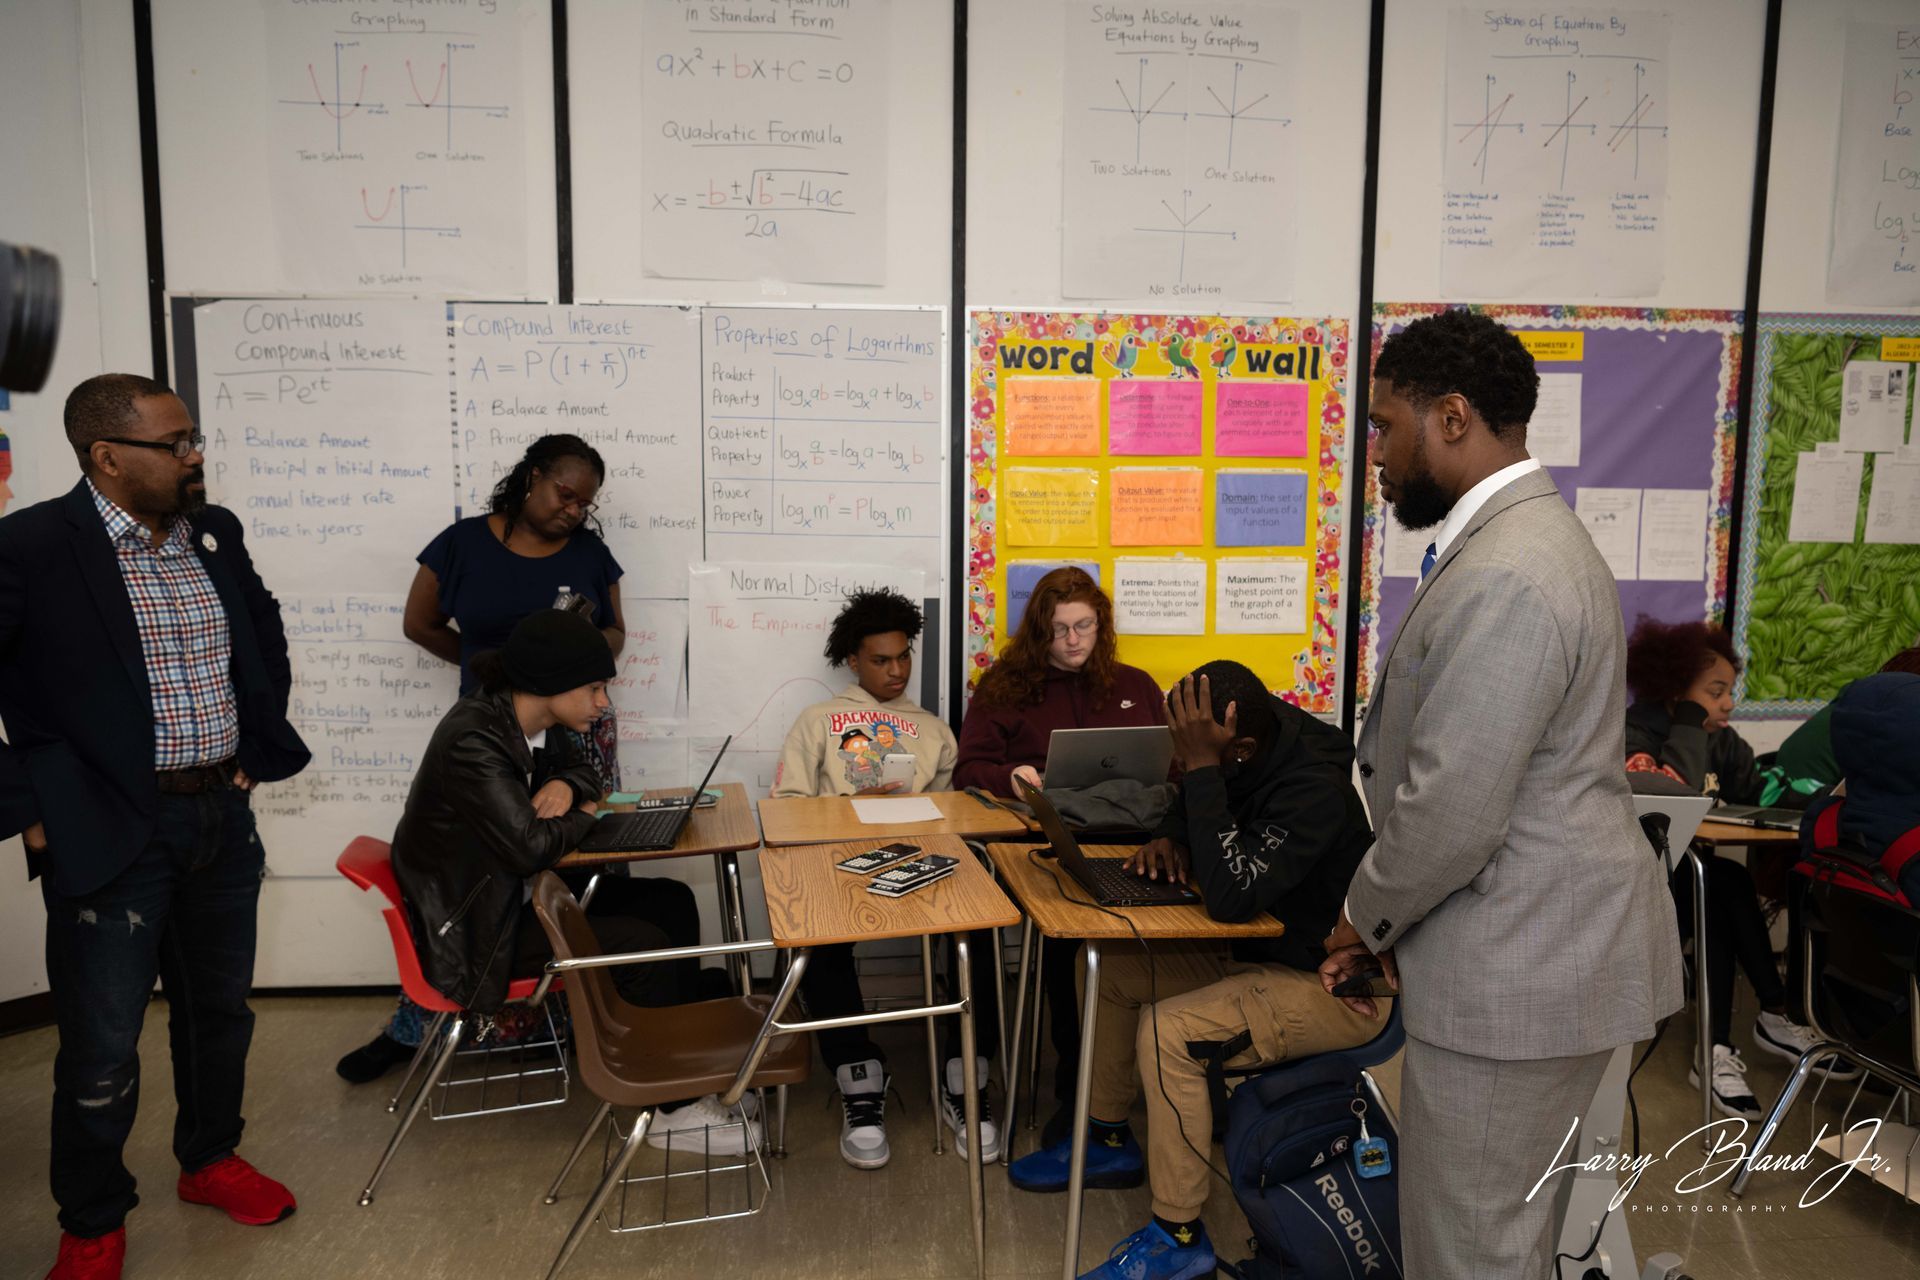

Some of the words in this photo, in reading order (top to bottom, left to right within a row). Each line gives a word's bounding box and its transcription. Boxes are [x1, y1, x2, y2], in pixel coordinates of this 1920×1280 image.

[351, 12, 426, 32] Graphing
[710, 6, 776, 24] Standard
[790, 9, 834, 30] Form
[1090, 5, 1135, 27] Solving
[1210, 15, 1243, 28] Value
[1609, 16, 1626, 36] By
[1105, 27, 1175, 46] Equations
[1181, 31, 1198, 50] by
[1204, 31, 1259, 53] Graphing
[1524, 33, 1579, 54] Graphing
[662, 120, 756, 142] Quadratic
[768, 120, 842, 145] Formula
[1884, 123, 1912, 137] Base
[244, 303, 364, 334] Continuous
[462, 314, 554, 341] Compound
[568, 311, 634, 336] Interest
[715, 316, 799, 353] Properties
[810, 325, 839, 352] of
[848, 327, 935, 357] Logarithms
[235, 341, 331, 367] Compound
[339, 340, 407, 361] Interest
[1000, 342, 1094, 375] word
[1246, 345, 1321, 380] wall
[712, 362, 756, 382] Product
[491, 397, 548, 417] Balance
[557, 401, 610, 417] Amount
[712, 388, 760, 407] Property
[245, 426, 309, 449] Balance
[319, 432, 371, 449] Amount
[625, 429, 679, 445] Amount
[708, 426, 768, 440] Quotient
[711, 447, 762, 465] Property
[250, 458, 307, 482] Principal
[336, 456, 373, 476] Initial
[380, 461, 432, 479] Amount
[609, 462, 646, 479] rate
[363, 491, 396, 505] rate
[712, 482, 751, 499] Power
[1261, 493, 1275, 502] the
[1278, 494, 1291, 502] set
[713, 506, 763, 527] Property
[1226, 506, 1249, 516] input
[1251, 506, 1279, 515] values
[1281, 505, 1290, 514] of
[618, 513, 640, 530] the
[1243, 518, 1281, 528] function
[297, 523, 313, 537] in
[319, 522, 366, 544] years
[731, 570, 794, 596] Normal
[1121, 579, 1156, 588] Extrema:
[1158, 579, 1182, 588] Points
[1184, 580, 1199, 588] that
[1227, 575, 1277, 584] Maximum:
[1280, 575, 1297, 584] The
[1138, 589, 1151, 597] the
[1152, 590, 1187, 598] locations
[1188, 589, 1197, 598] of
[1225, 587, 1258, 598] highest
[1260, 588, 1284, 597] point
[312, 600, 335, 614] and
[1120, 599, 1155, 609] relatively
[1157, 600, 1173, 609] high
[1186, 600, 1200, 608] low
[1129, 609, 1161, 618] function
[1230, 600, 1245, 609] the
[1247, 600, 1273, 610] graph
[1275, 598, 1285, 608] of
[704, 605, 740, 630] The
[752, 612, 827, 636] Empirical
[1241, 611, 1281, 621] function.
[285, 619, 364, 638] robability
[306, 649, 350, 670] Simply
[358, 651, 404, 668] means
[336, 677, 347, 687] is
[353, 676, 370, 688] to
[380, 671, 432, 696] happen
[293, 700, 371, 720] Probability
[385, 705, 398, 718] is
[404, 704, 442, 718] what
[830, 711, 917, 736] BACKWOODS
[331, 746, 413, 769] Probability
[1314, 1173, 1381, 1276] Reebok
